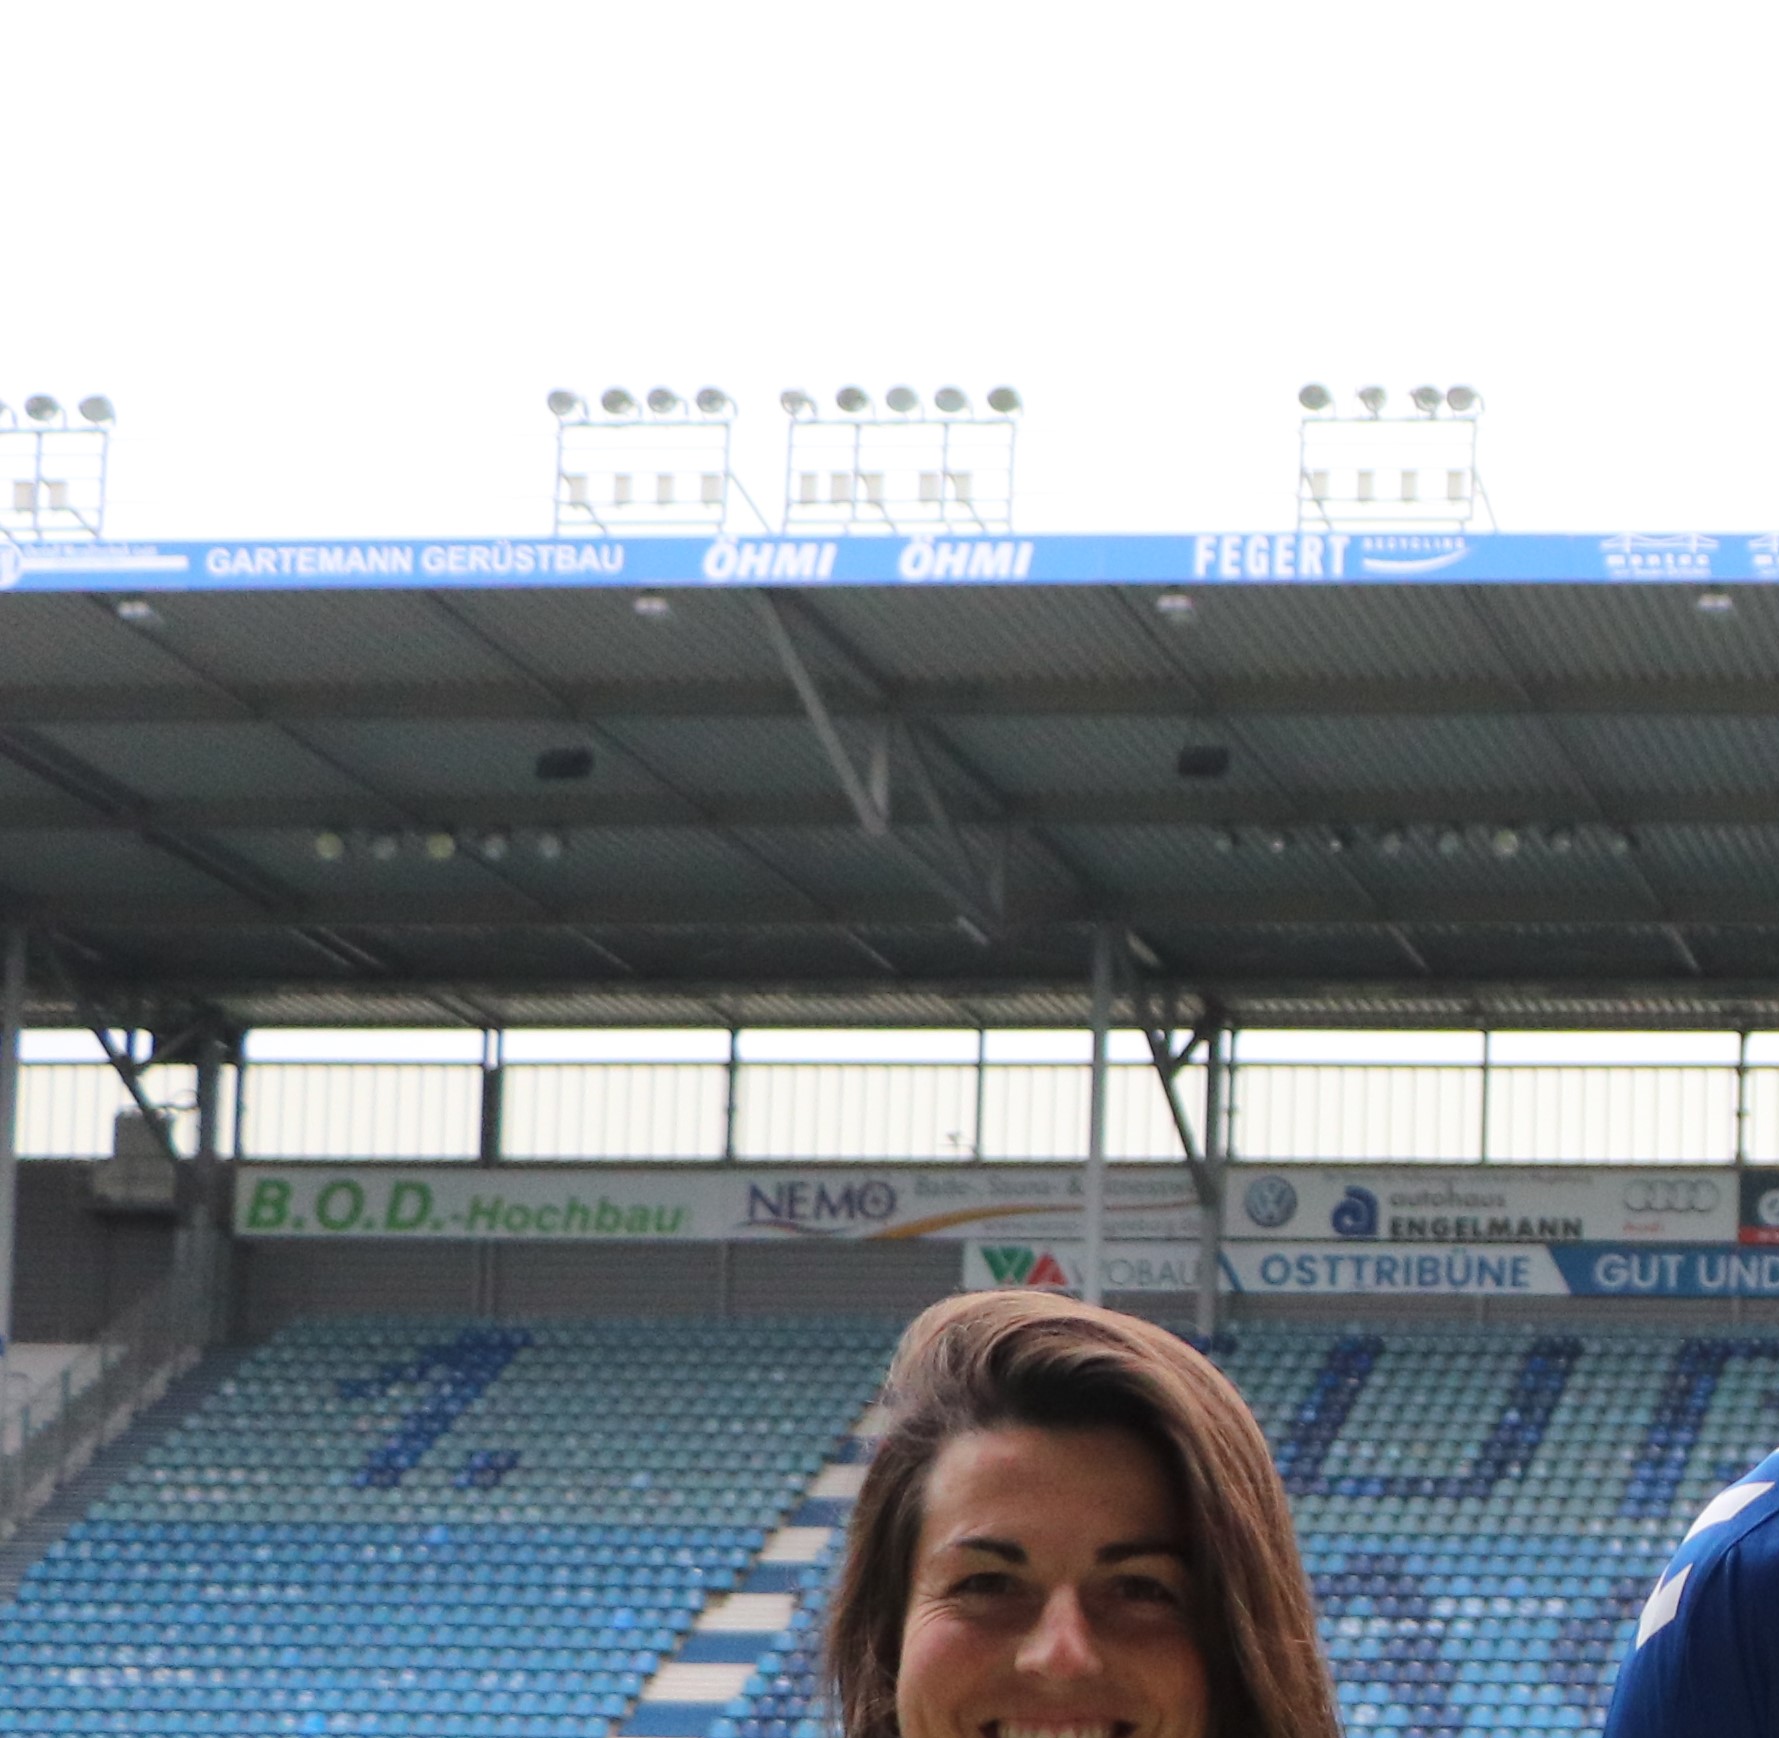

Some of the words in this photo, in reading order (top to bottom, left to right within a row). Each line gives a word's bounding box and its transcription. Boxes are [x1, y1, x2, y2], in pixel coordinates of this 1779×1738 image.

[206, 544, 414, 576] GARTEMANN
[420, 539, 625, 574] GERÜSTBAU
[703, 534, 837, 579] ÖHMI
[899, 534, 1034, 580] ÖHMI
[1194, 536, 1350, 578] FEGERT
[747, 1179, 898, 1221] NEMO
[1390, 1216, 1583, 1238] ENGELMANN
[1260, 1249, 1531, 1289] OSTTRIBÜNE
[1594, 1252, 1686, 1290] GUT
